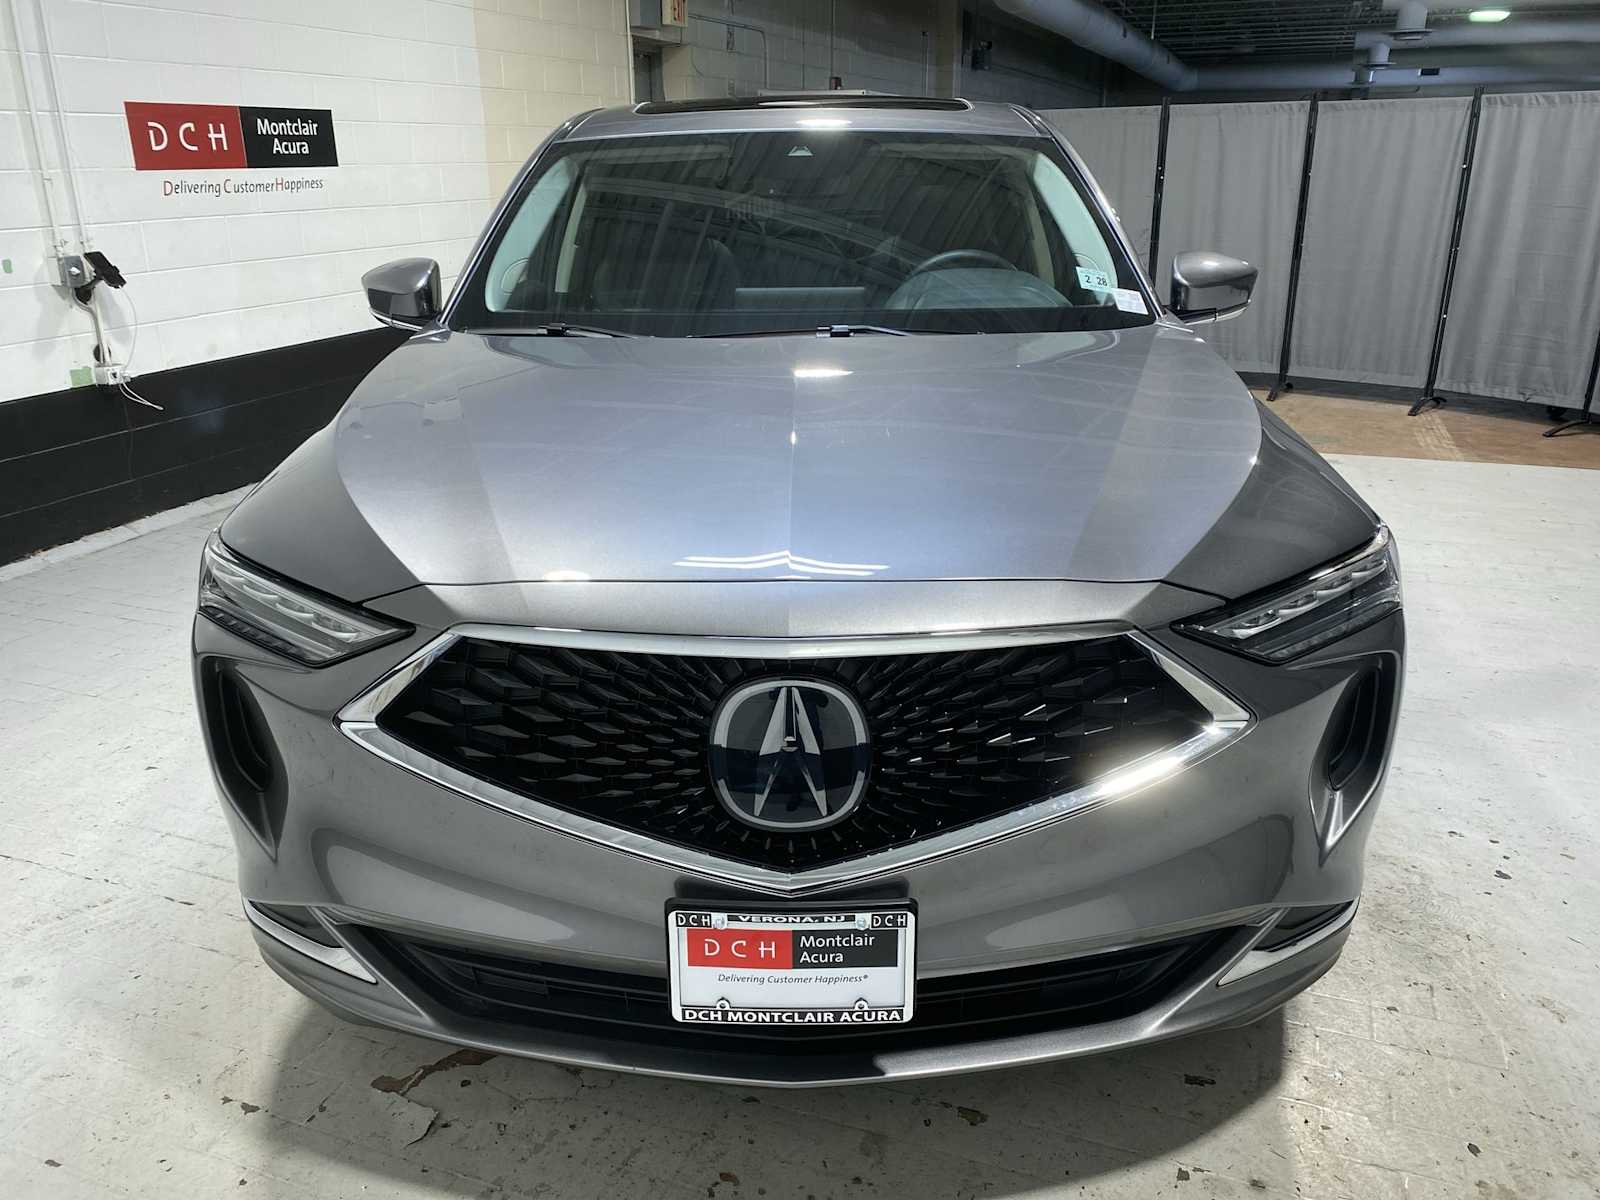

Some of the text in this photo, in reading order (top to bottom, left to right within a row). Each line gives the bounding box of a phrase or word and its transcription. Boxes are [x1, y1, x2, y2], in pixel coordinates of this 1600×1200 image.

[256, 118, 319, 136] Montclair
[272, 138, 310, 154] Acura
[163, 177, 324, 197] Delivering Customer Happiness
[1085, 275, 1091, 283] 2
[676, 914, 712, 927] DCH
[823, 915, 846, 923] NJ
[872, 914, 907, 927] DCH
[800, 933, 876, 948] Montclair
[704, 938, 776, 959] DCH
[800, 951, 844, 964] Acura
[718, 974, 765, 985] Delivering
[767, 975, 812, 984] Customer
[684, 1010, 901, 1023] DCH MONTCLAIR ACURA
